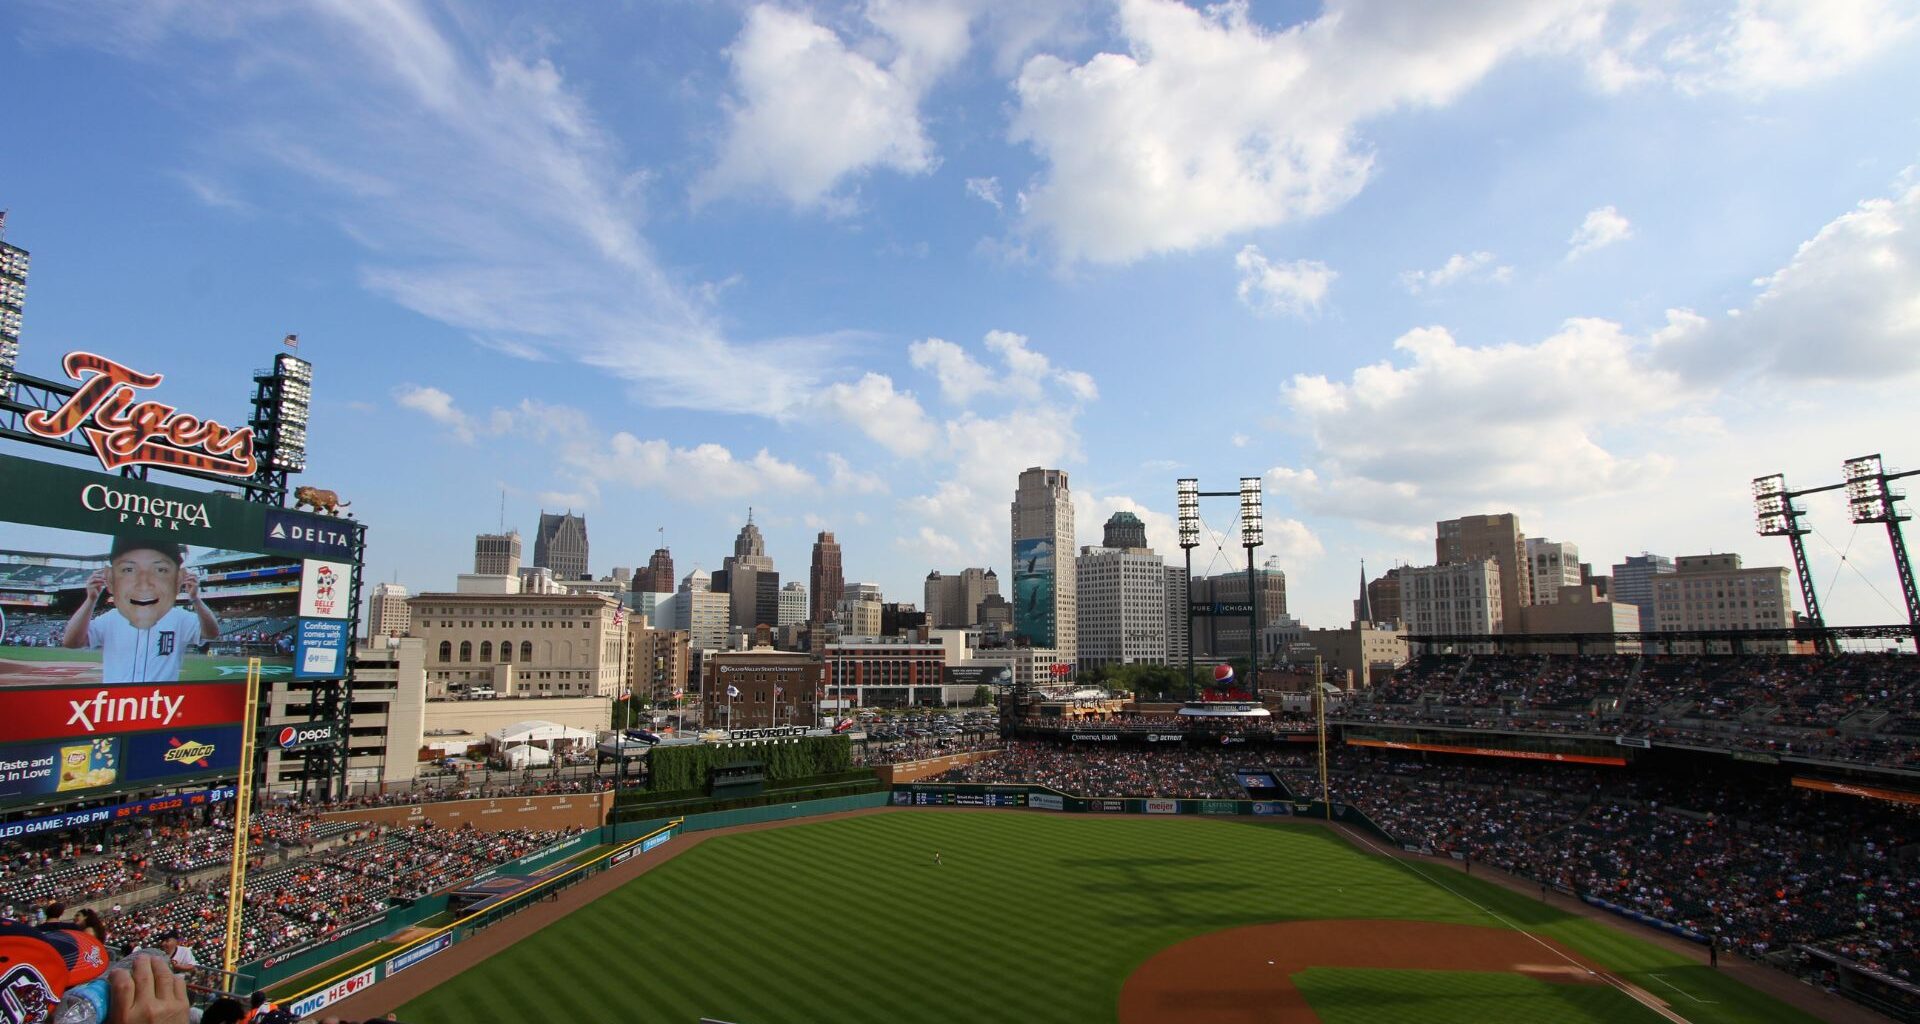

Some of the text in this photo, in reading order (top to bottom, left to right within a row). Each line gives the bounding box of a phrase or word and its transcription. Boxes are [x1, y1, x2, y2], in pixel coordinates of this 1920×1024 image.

[25, 351, 258, 476] Tigers
[119, 513, 180, 531] PARK
[291, 526, 348, 547] DELTA
[314, 599, 335, 608] BELLE
[316, 607, 331, 615] TIRE
[304, 621, 341, 631] Confidence
[326, 630, 341, 639] with
[303, 639, 322, 648] every
[66, 689, 185, 731] xfinity
[298, 726, 331, 743] pepsi
[730, 726, 810, 740] CHEVROLET
[716, 739, 799, 748] FOUNTAIN
[166, 745, 214, 760] SUNOCO
[31, 755, 54, 767] and
[8, 771, 20, 781] In
[22, 769, 51, 779] Love
[410, 807, 422, 815] 23
[1149, 802, 1173, 811] meijer
[26, 819, 63, 833] GAME:
[66, 814, 90, 826] 7:08
[92, 810, 109, 821] PM
[293, 995, 325, 1016] DMC
